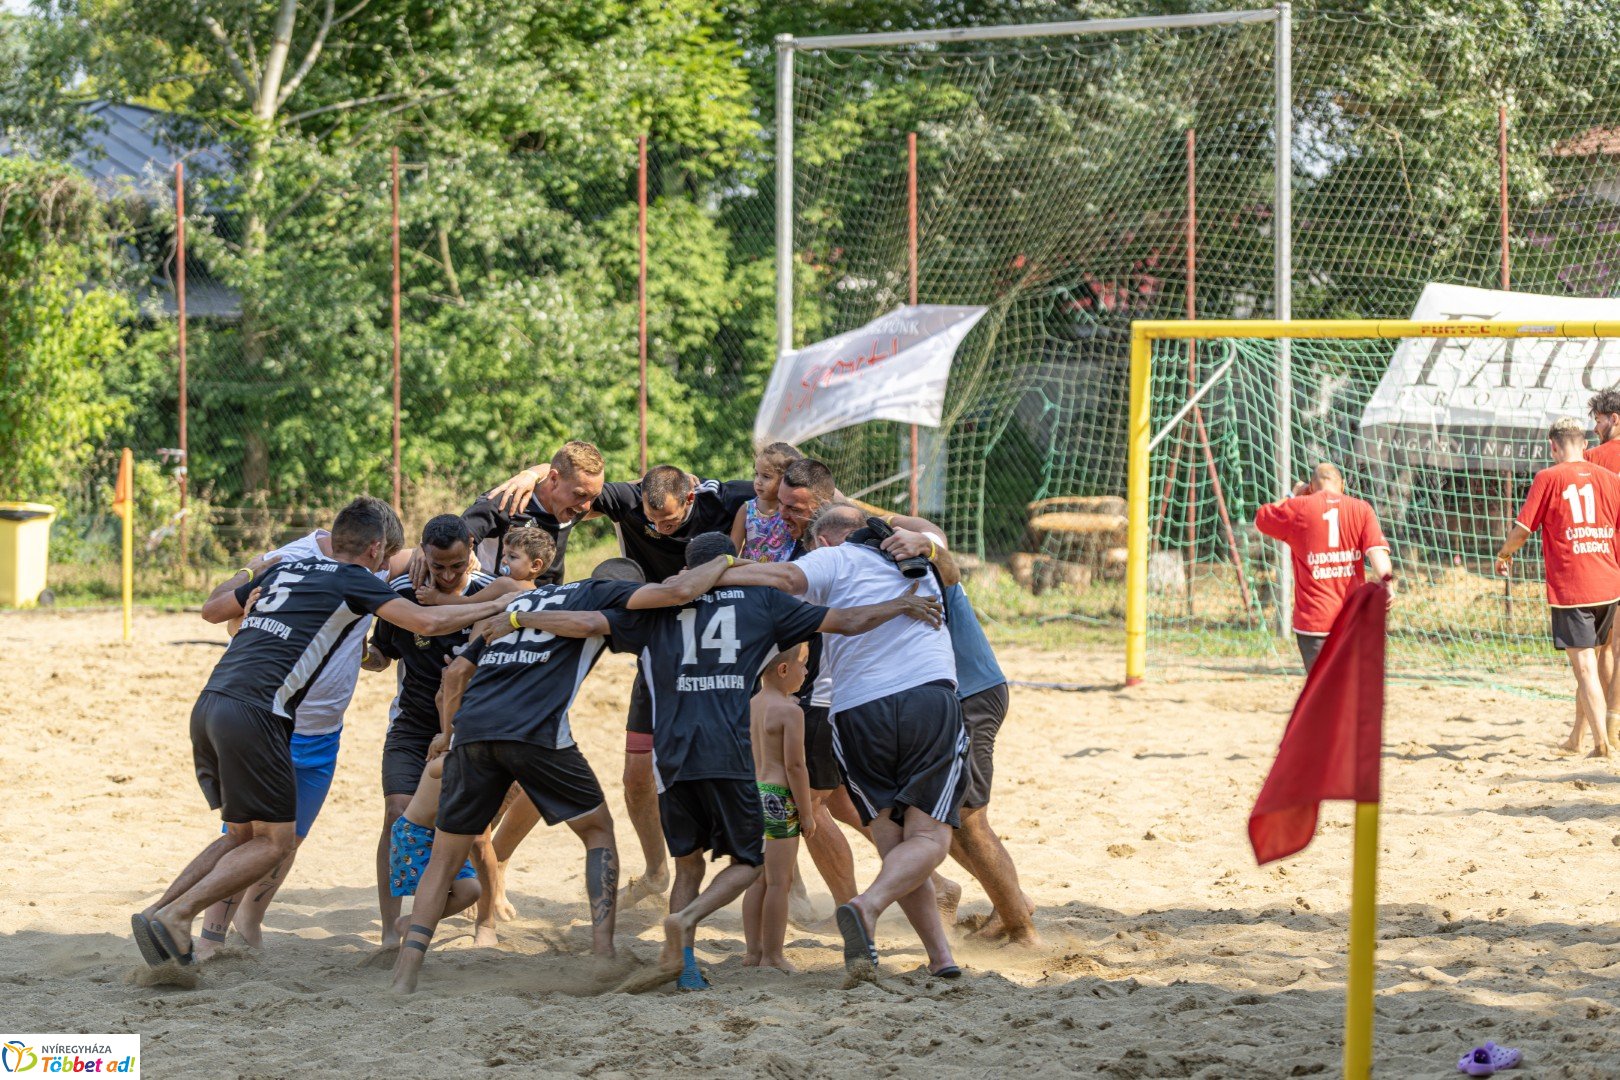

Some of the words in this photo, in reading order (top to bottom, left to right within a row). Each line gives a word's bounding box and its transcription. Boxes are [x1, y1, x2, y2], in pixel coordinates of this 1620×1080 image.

[1562, 483, 1596, 524] 11
[1322, 508, 1340, 548] 1
[255, 571, 305, 612] 5
[714, 589, 745, 600] Team
[261, 617, 293, 641] KUPA
[676, 604, 742, 666] 14
[676, 673, 715, 692] ÁSTYA
